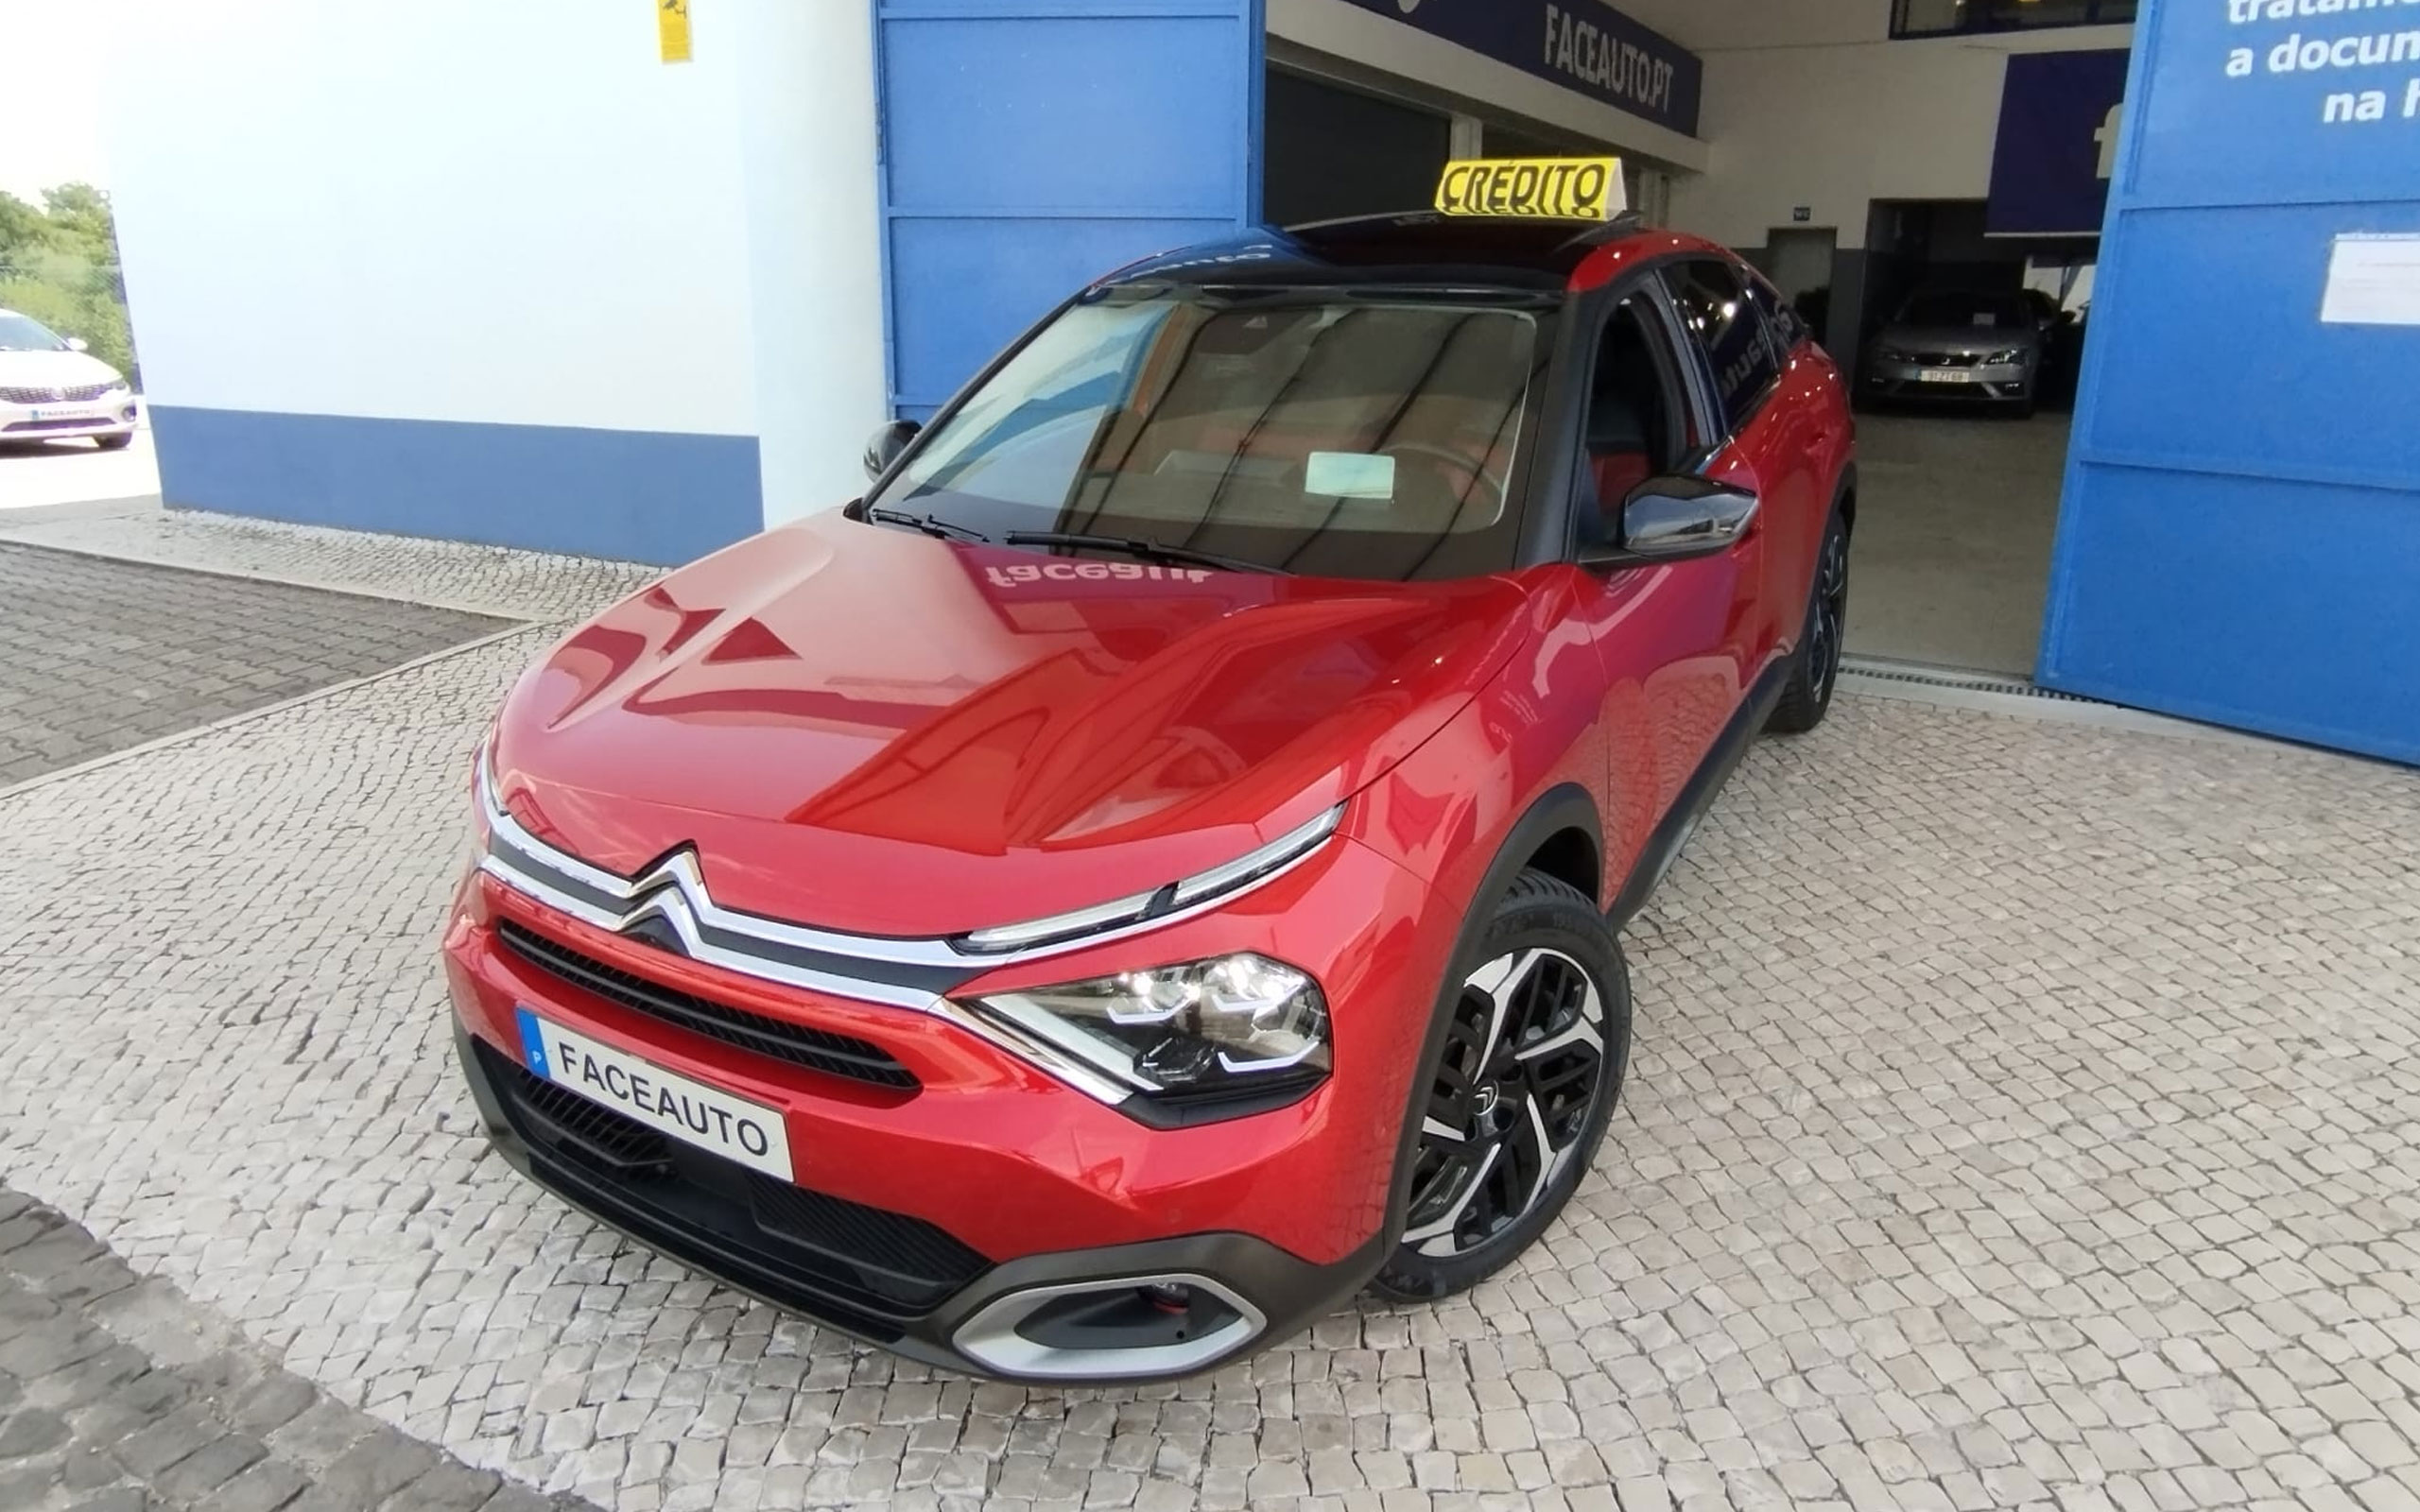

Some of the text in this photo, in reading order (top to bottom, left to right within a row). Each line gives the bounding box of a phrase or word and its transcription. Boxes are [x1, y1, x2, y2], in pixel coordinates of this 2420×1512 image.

[1545, 3, 1673, 113] FACEAUTO.PT
[2226, 48, 2254, 77] a
[2323, 90, 2386, 123] na
[532, 1042, 768, 1157] P FACEAUTO
